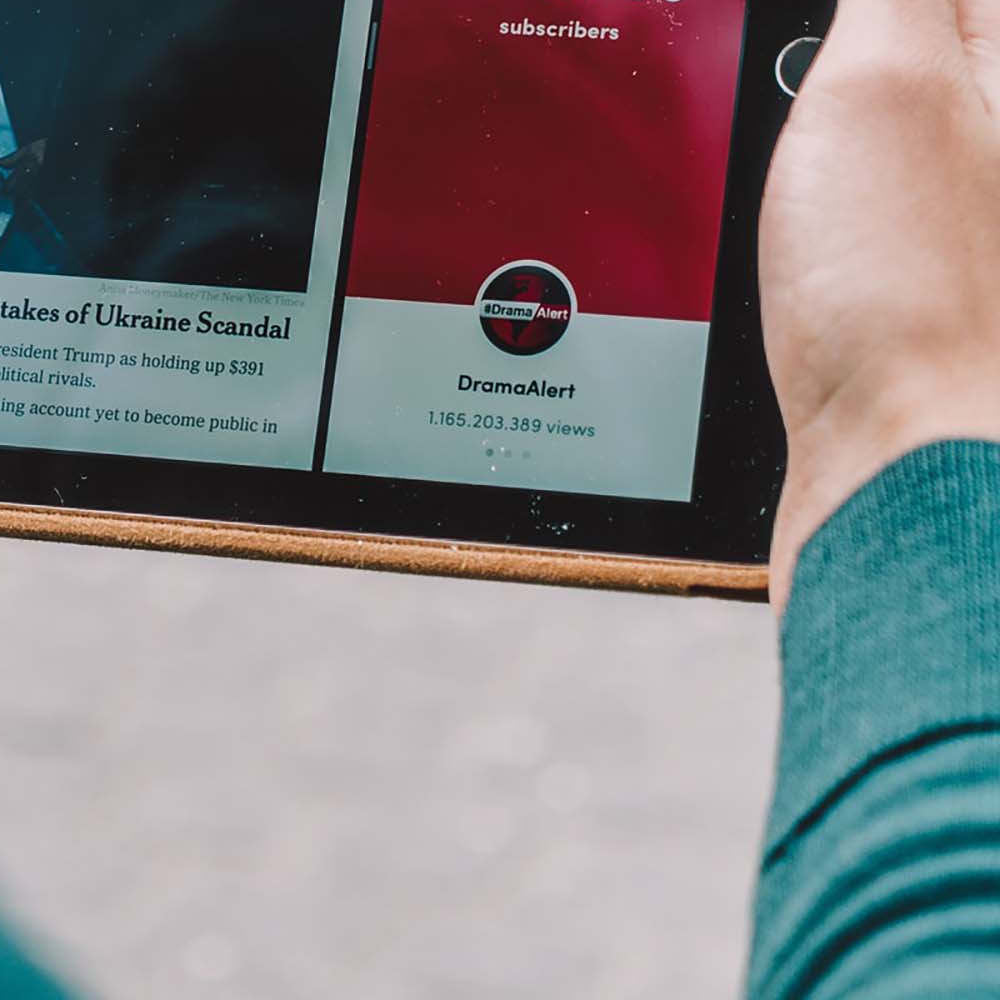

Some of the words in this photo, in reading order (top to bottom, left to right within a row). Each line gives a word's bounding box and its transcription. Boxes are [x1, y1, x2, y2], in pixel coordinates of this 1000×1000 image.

[499, 18, 620, 40] subscribers
[65, 303, 91, 325] of
[95, 304, 191, 332] Ukraine
[196, 311, 291, 339] Scandal
[63, 347, 115, 368] Trump
[119, 354, 137, 366] as
[141, 353, 200, 374] holding
[204, 361, 225, 376] up
[229, 359, 264, 376] $391
[48, 371, 96, 388] rivals.
[458, 374, 576, 399] DramaAlert
[29, 403, 90, 419] account
[94, 407, 120, 422] yet
[124, 409, 140, 422] to
[144, 409, 205, 427] become
[209, 415, 258, 432] public
[262, 418, 278, 434] in
[428, 411, 542, 433] 1.165.203.389
[546, 419, 595, 437] views
